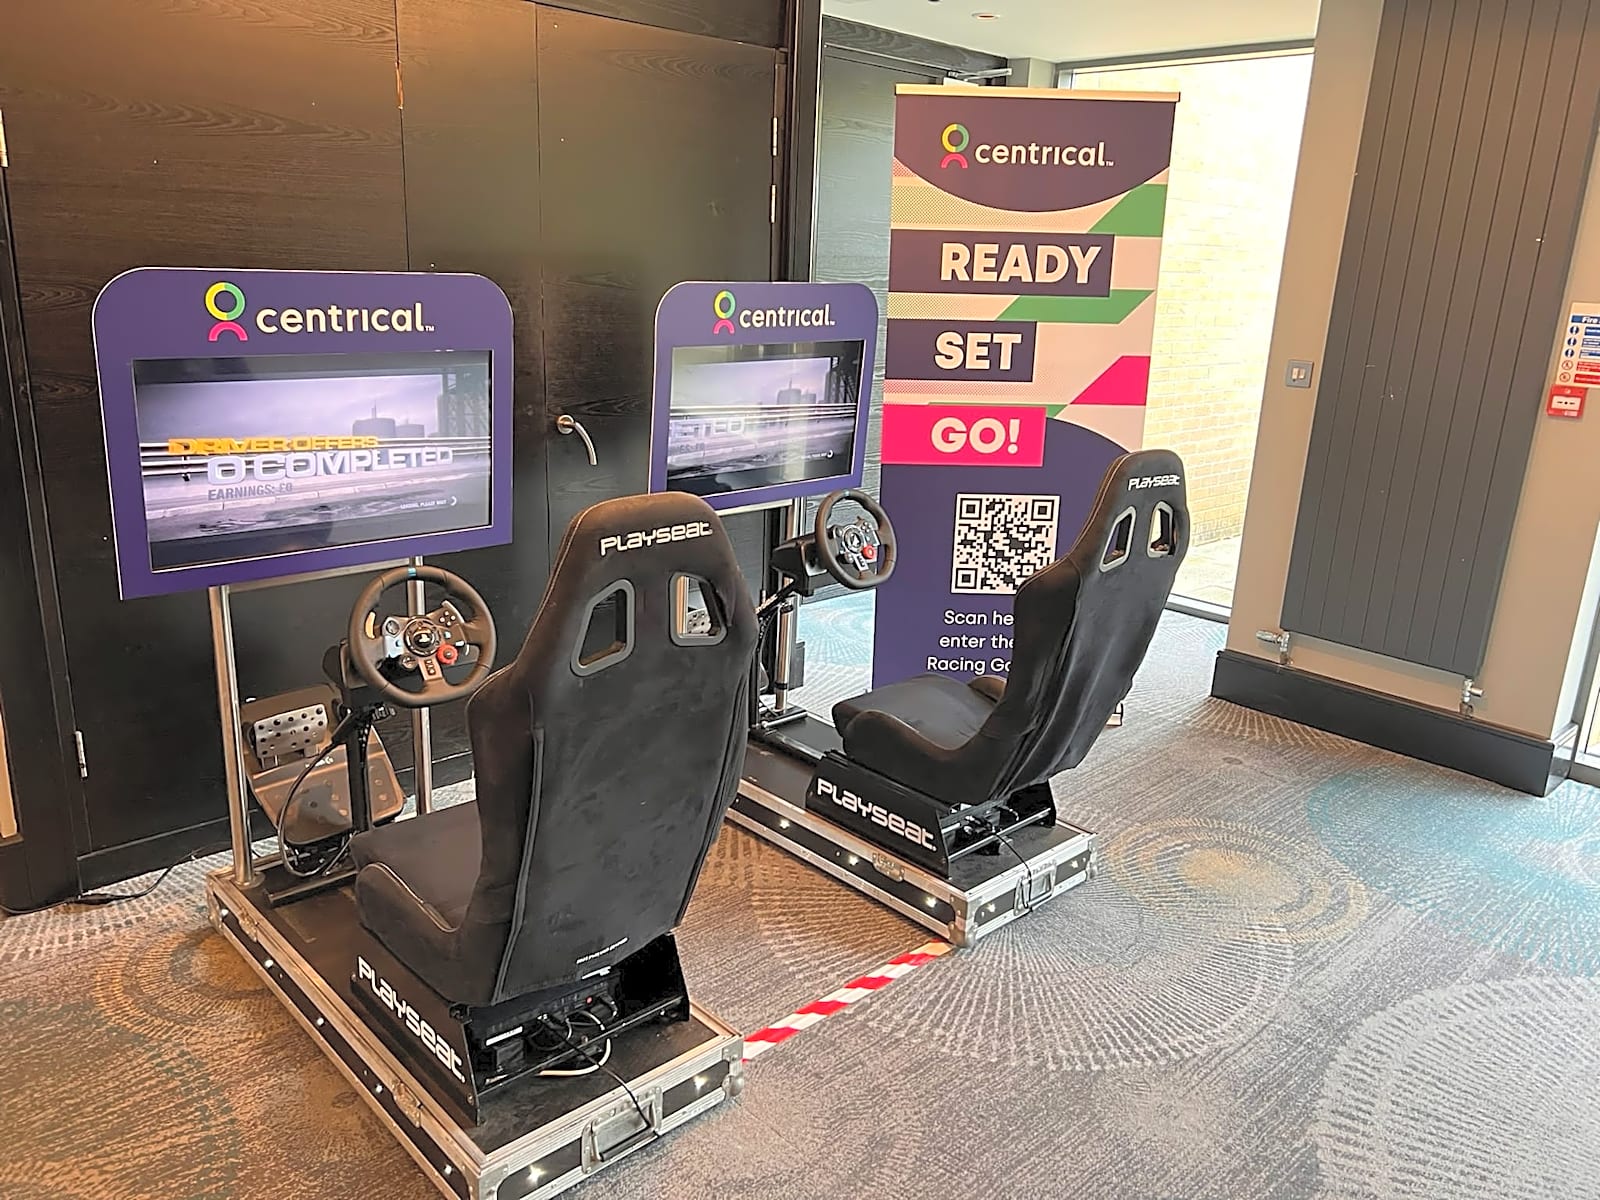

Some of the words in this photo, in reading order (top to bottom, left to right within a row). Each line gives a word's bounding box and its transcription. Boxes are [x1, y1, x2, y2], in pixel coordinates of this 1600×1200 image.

[974, 141, 1105, 166] centrical
[940, 242, 1101, 285] READY
[256, 303, 424, 333] centrical
[739, 303, 830, 328] centrical
[934, 331, 1022, 370] SET
[168, 436, 290, 456] DRIVER
[294, 435, 379, 452] OFFERS
[931, 417, 1021, 455] GO!
[254, 446, 453, 482] COMPLETED
[208, 484, 275, 501] EARNINGS:
[944, 610, 987, 625] Scan
[939, 634, 986, 649] enter
[927, 656, 986, 675] Racing
